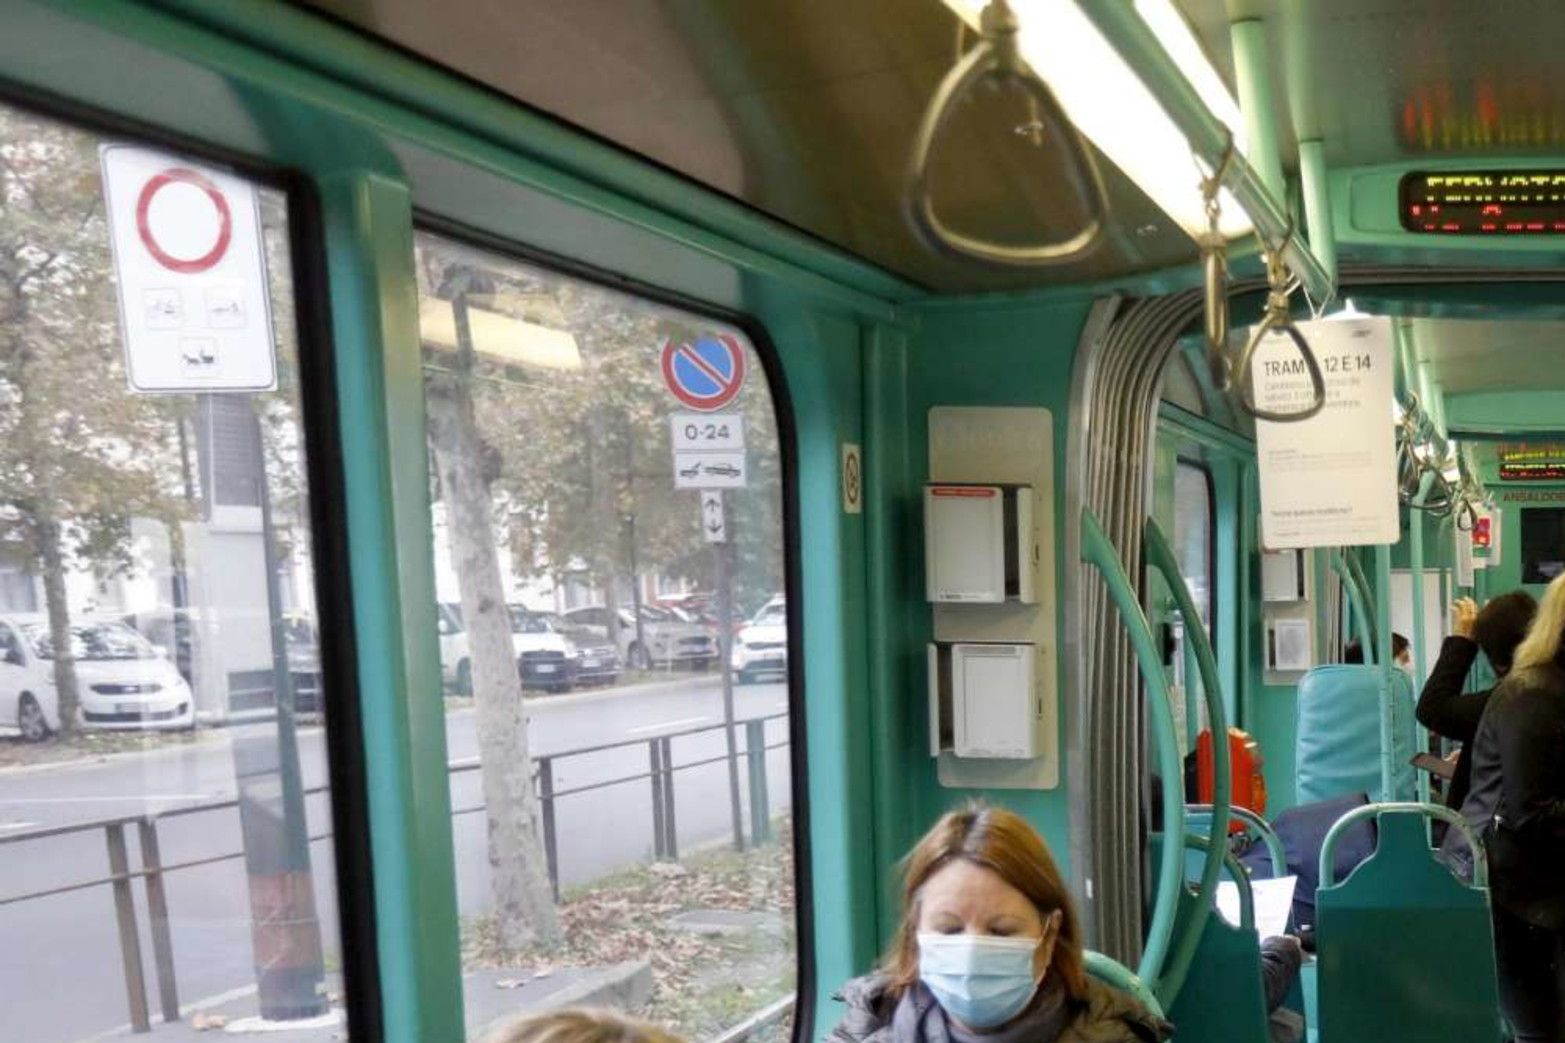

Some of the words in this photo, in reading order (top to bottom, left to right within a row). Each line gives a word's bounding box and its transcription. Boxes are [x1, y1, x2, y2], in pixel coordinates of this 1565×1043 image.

[1264, 358, 1305, 376] TRAM
[1324, 358, 1339, 373] 12
[1342, 355, 1352, 371] E
[1356, 354, 1372, 371] 14
[685, 425, 730, 440] 0-24
